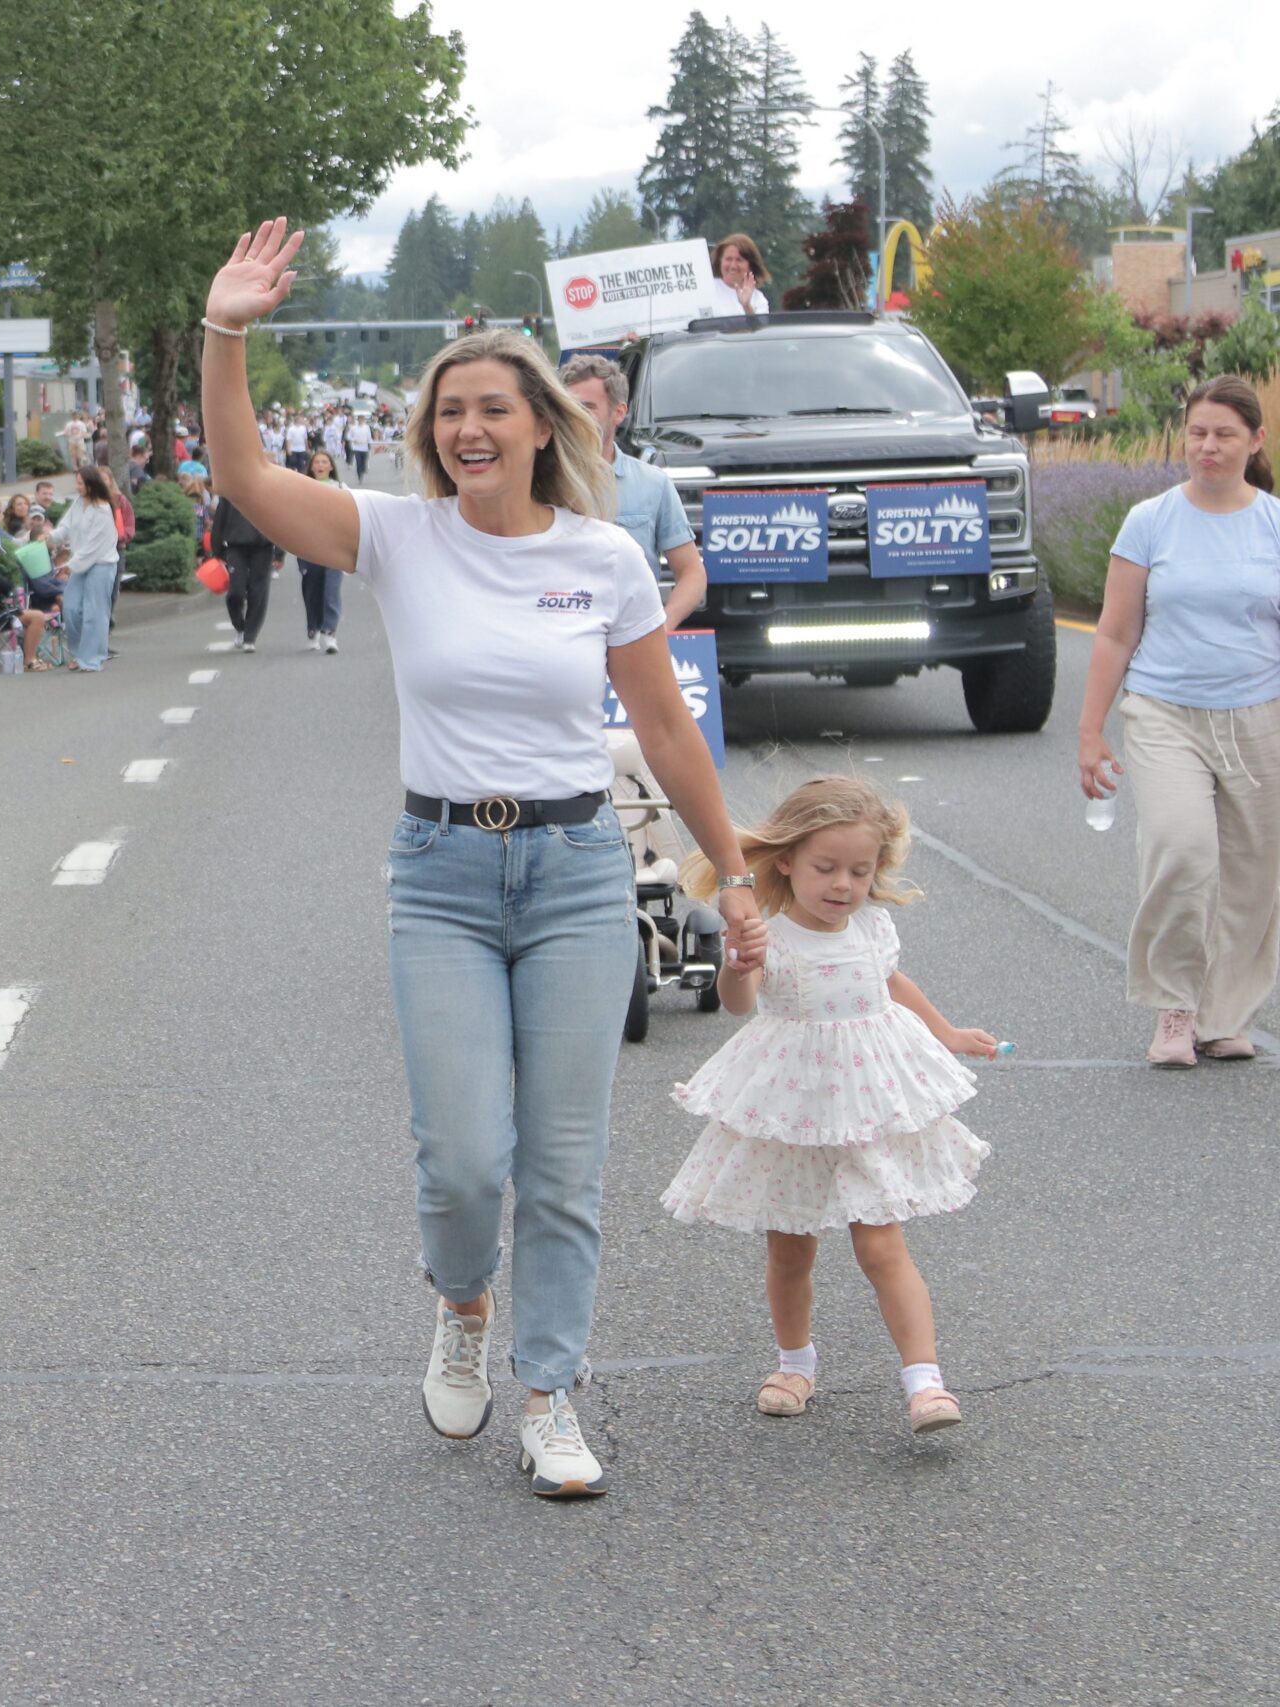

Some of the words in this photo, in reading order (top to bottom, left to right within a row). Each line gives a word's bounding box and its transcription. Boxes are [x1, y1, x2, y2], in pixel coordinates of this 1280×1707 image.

[600, 272, 624, 290] THE
[625, 266, 670, 286] INCOME
[672, 262, 696, 280] TAX
[568, 284, 595, 303] STOP
[604, 290, 623, 302] VOTE
[623, 287, 637, 299] YES
[637, 286, 648, 297] ON
[650, 278, 697, 296] IP26-645
[834, 503, 867, 519] Ford
[877, 507, 931, 520] KRISTINA
[712, 515, 768, 525] KRISTINA
[707, 527, 822, 552] SOLTYS
[875, 518, 983, 546] SOLTYS
[537, 597, 592, 610] SOLTYS
